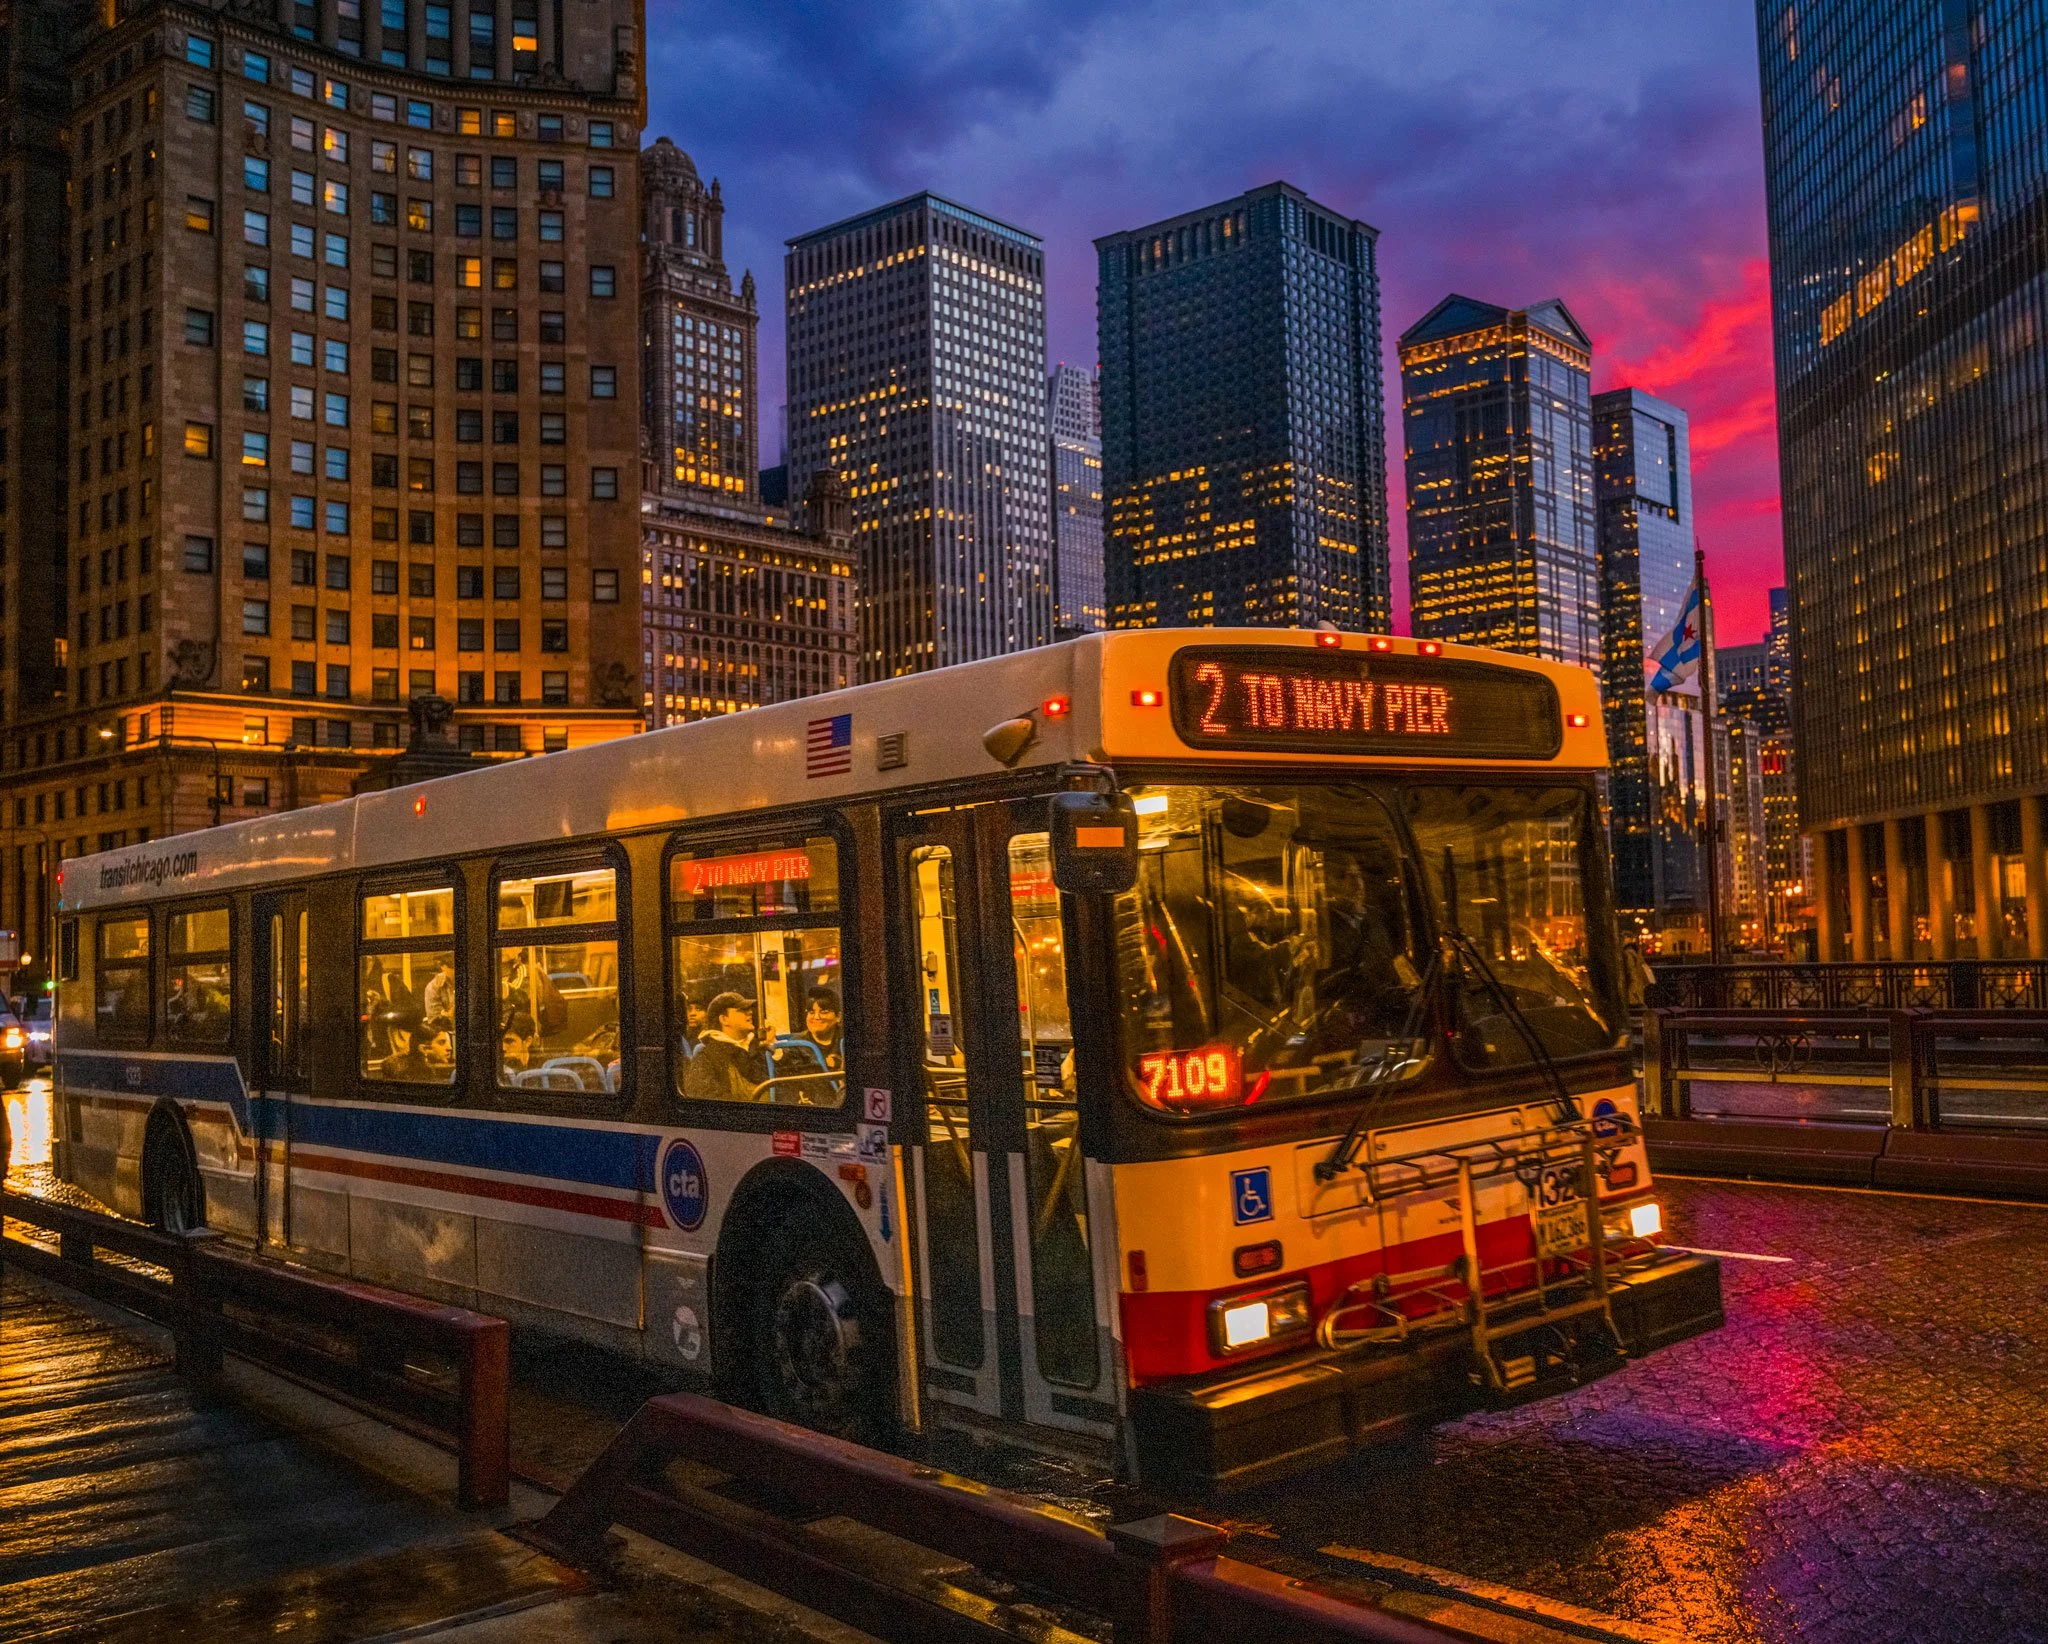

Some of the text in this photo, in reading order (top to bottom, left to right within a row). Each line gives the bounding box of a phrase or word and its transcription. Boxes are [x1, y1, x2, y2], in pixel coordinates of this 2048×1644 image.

[1195, 662, 1450, 734] 2 TO NAVY PIER
[100, 850, 198, 889] transitchicago.com
[692, 855, 809, 895] 2 TO NAVY PIER
[1143, 1053, 1227, 1099] 7109
[669, 1169, 702, 1200] cta
